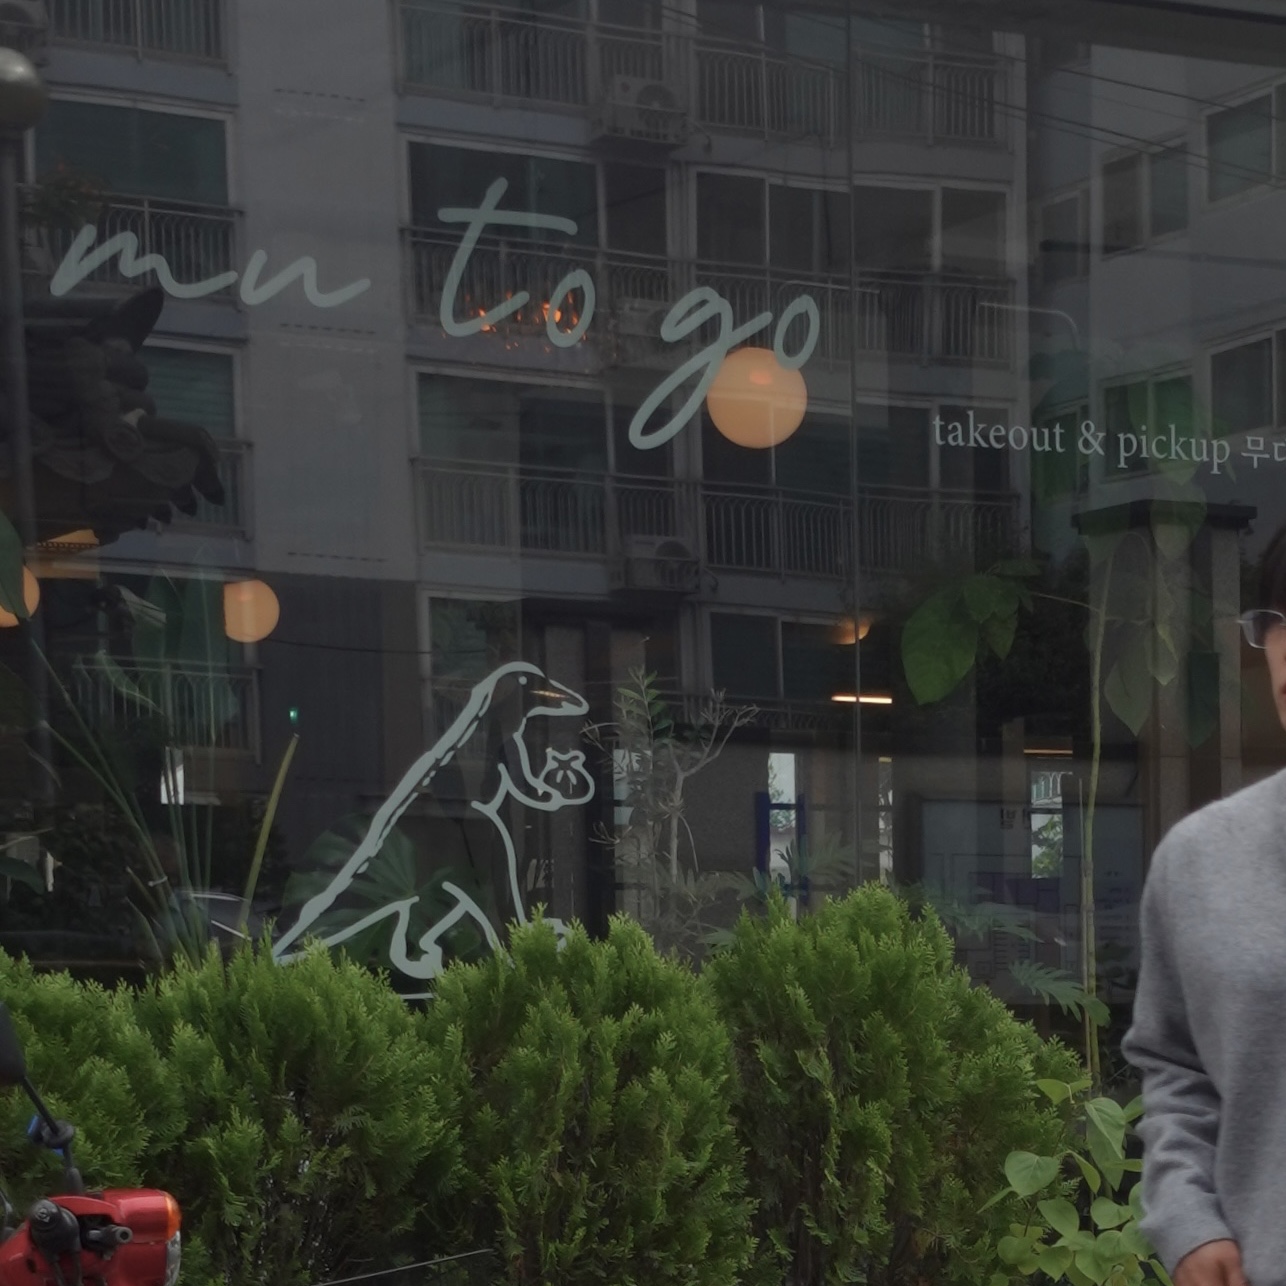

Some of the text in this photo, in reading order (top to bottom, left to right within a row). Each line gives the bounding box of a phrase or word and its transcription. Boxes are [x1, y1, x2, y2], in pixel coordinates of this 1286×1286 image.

[437, 176, 596, 348] to
[628, 285, 821, 450] go
[932, 411, 1064, 453] takeout
[1077, 420, 1106, 456] &
[1117, 424, 1230, 474] pickup
